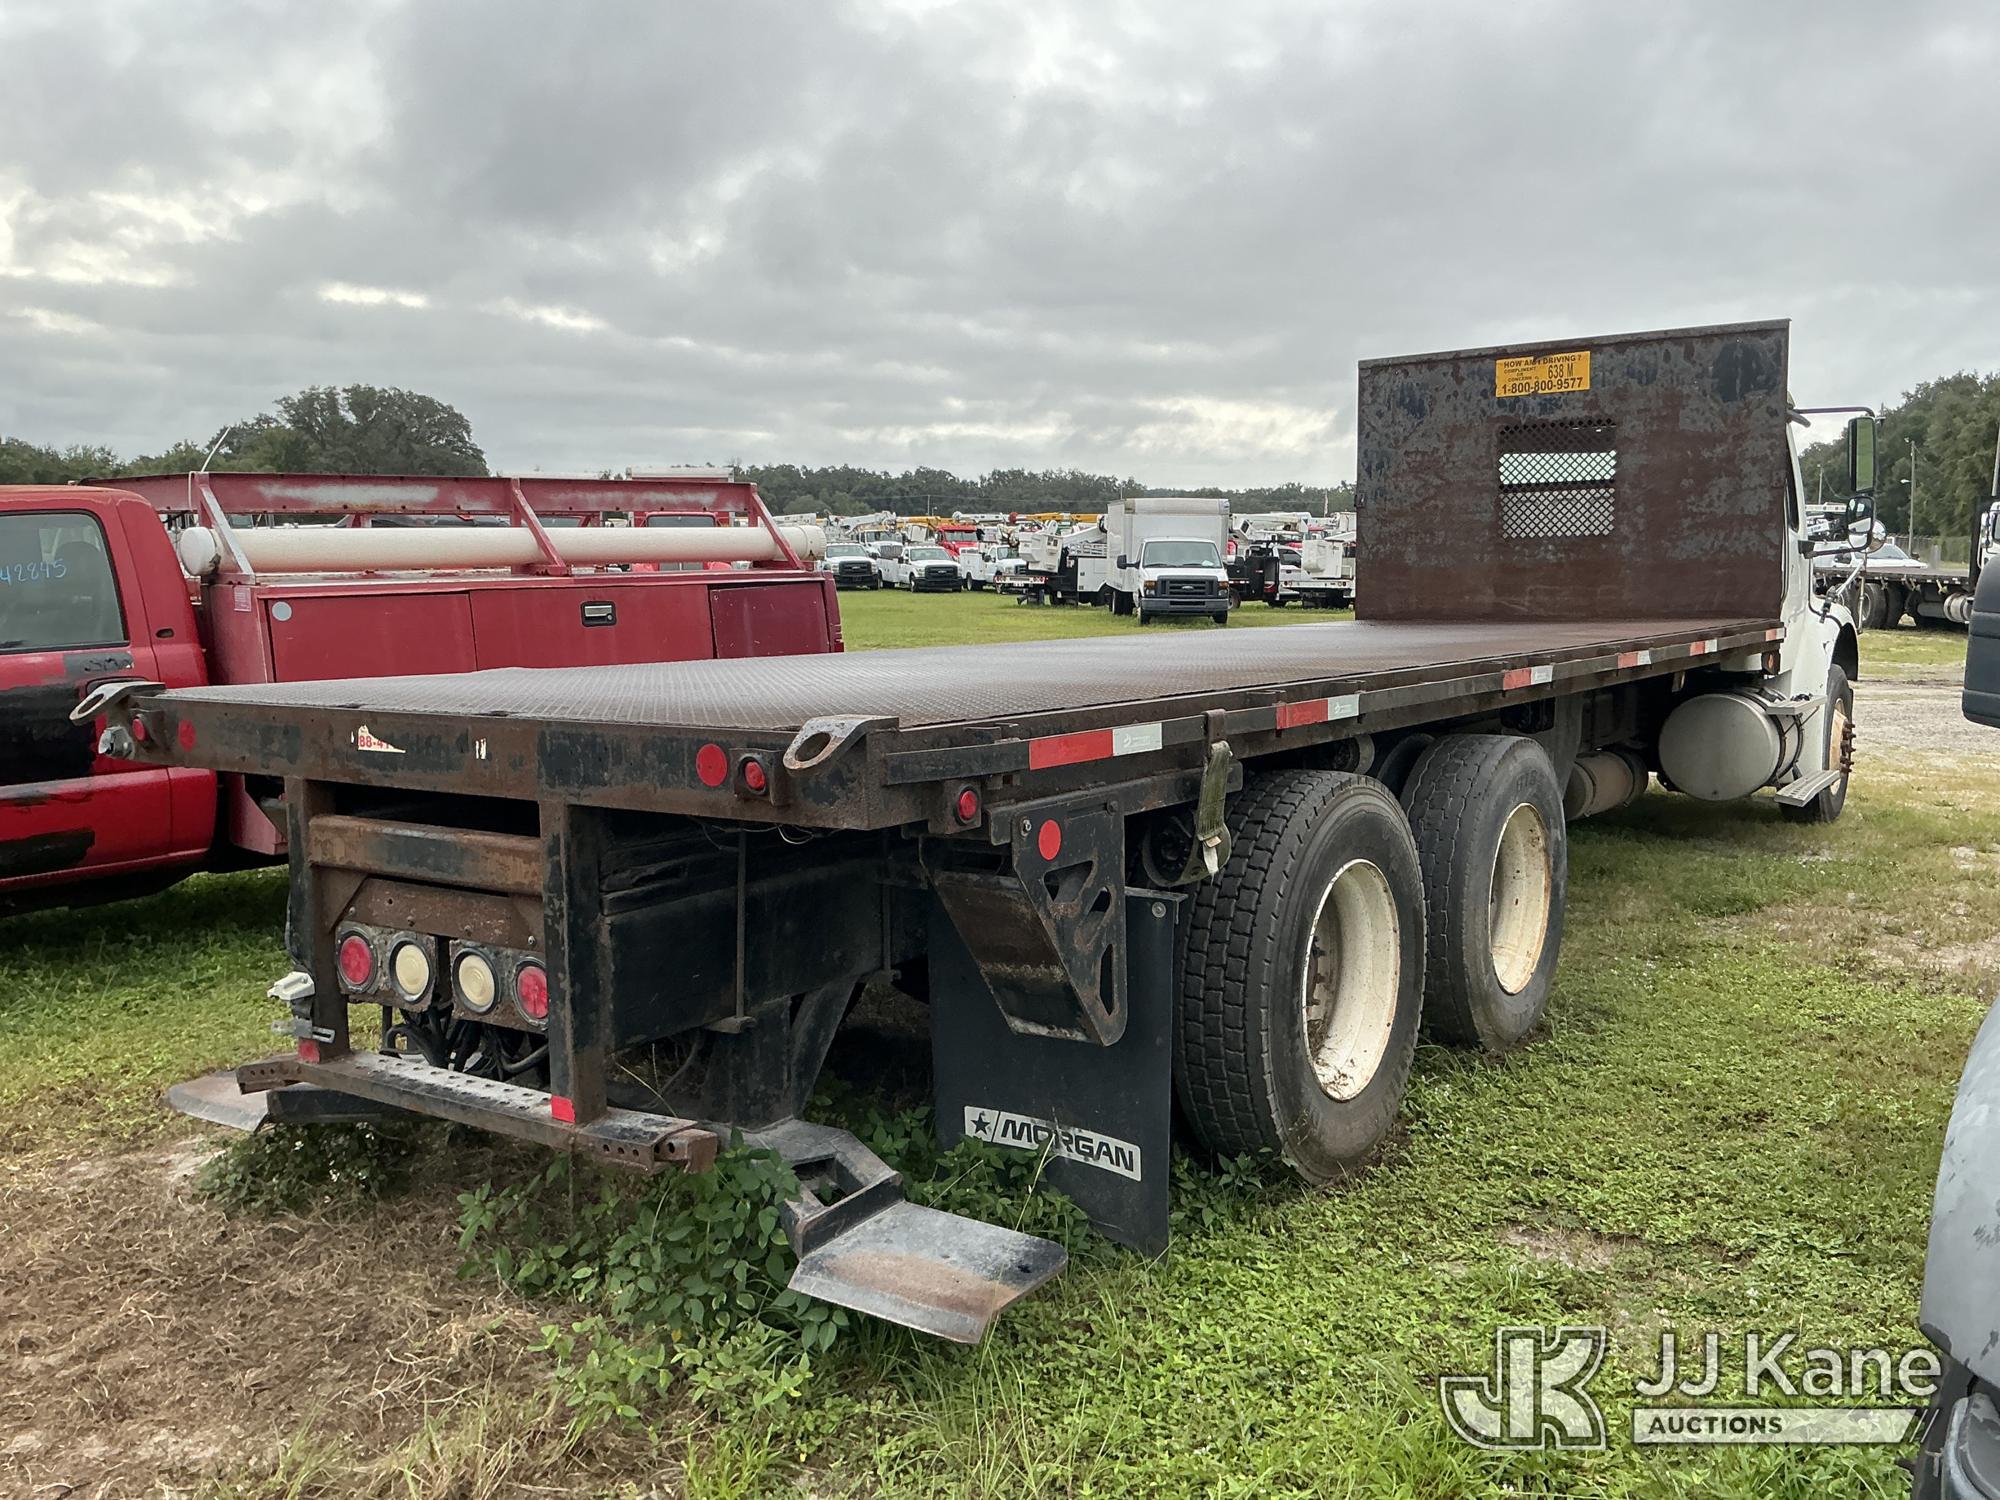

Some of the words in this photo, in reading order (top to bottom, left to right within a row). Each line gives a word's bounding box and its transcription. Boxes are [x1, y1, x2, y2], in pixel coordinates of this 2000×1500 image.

[1504, 360, 1521, 368] HOW
[1543, 355, 1576, 365] DRIVING
[1548, 364, 1564, 379] 638
[1502, 377, 1583, 394] 1-800-800-9577
[1001, 1119, 1134, 1172] MORGAN
